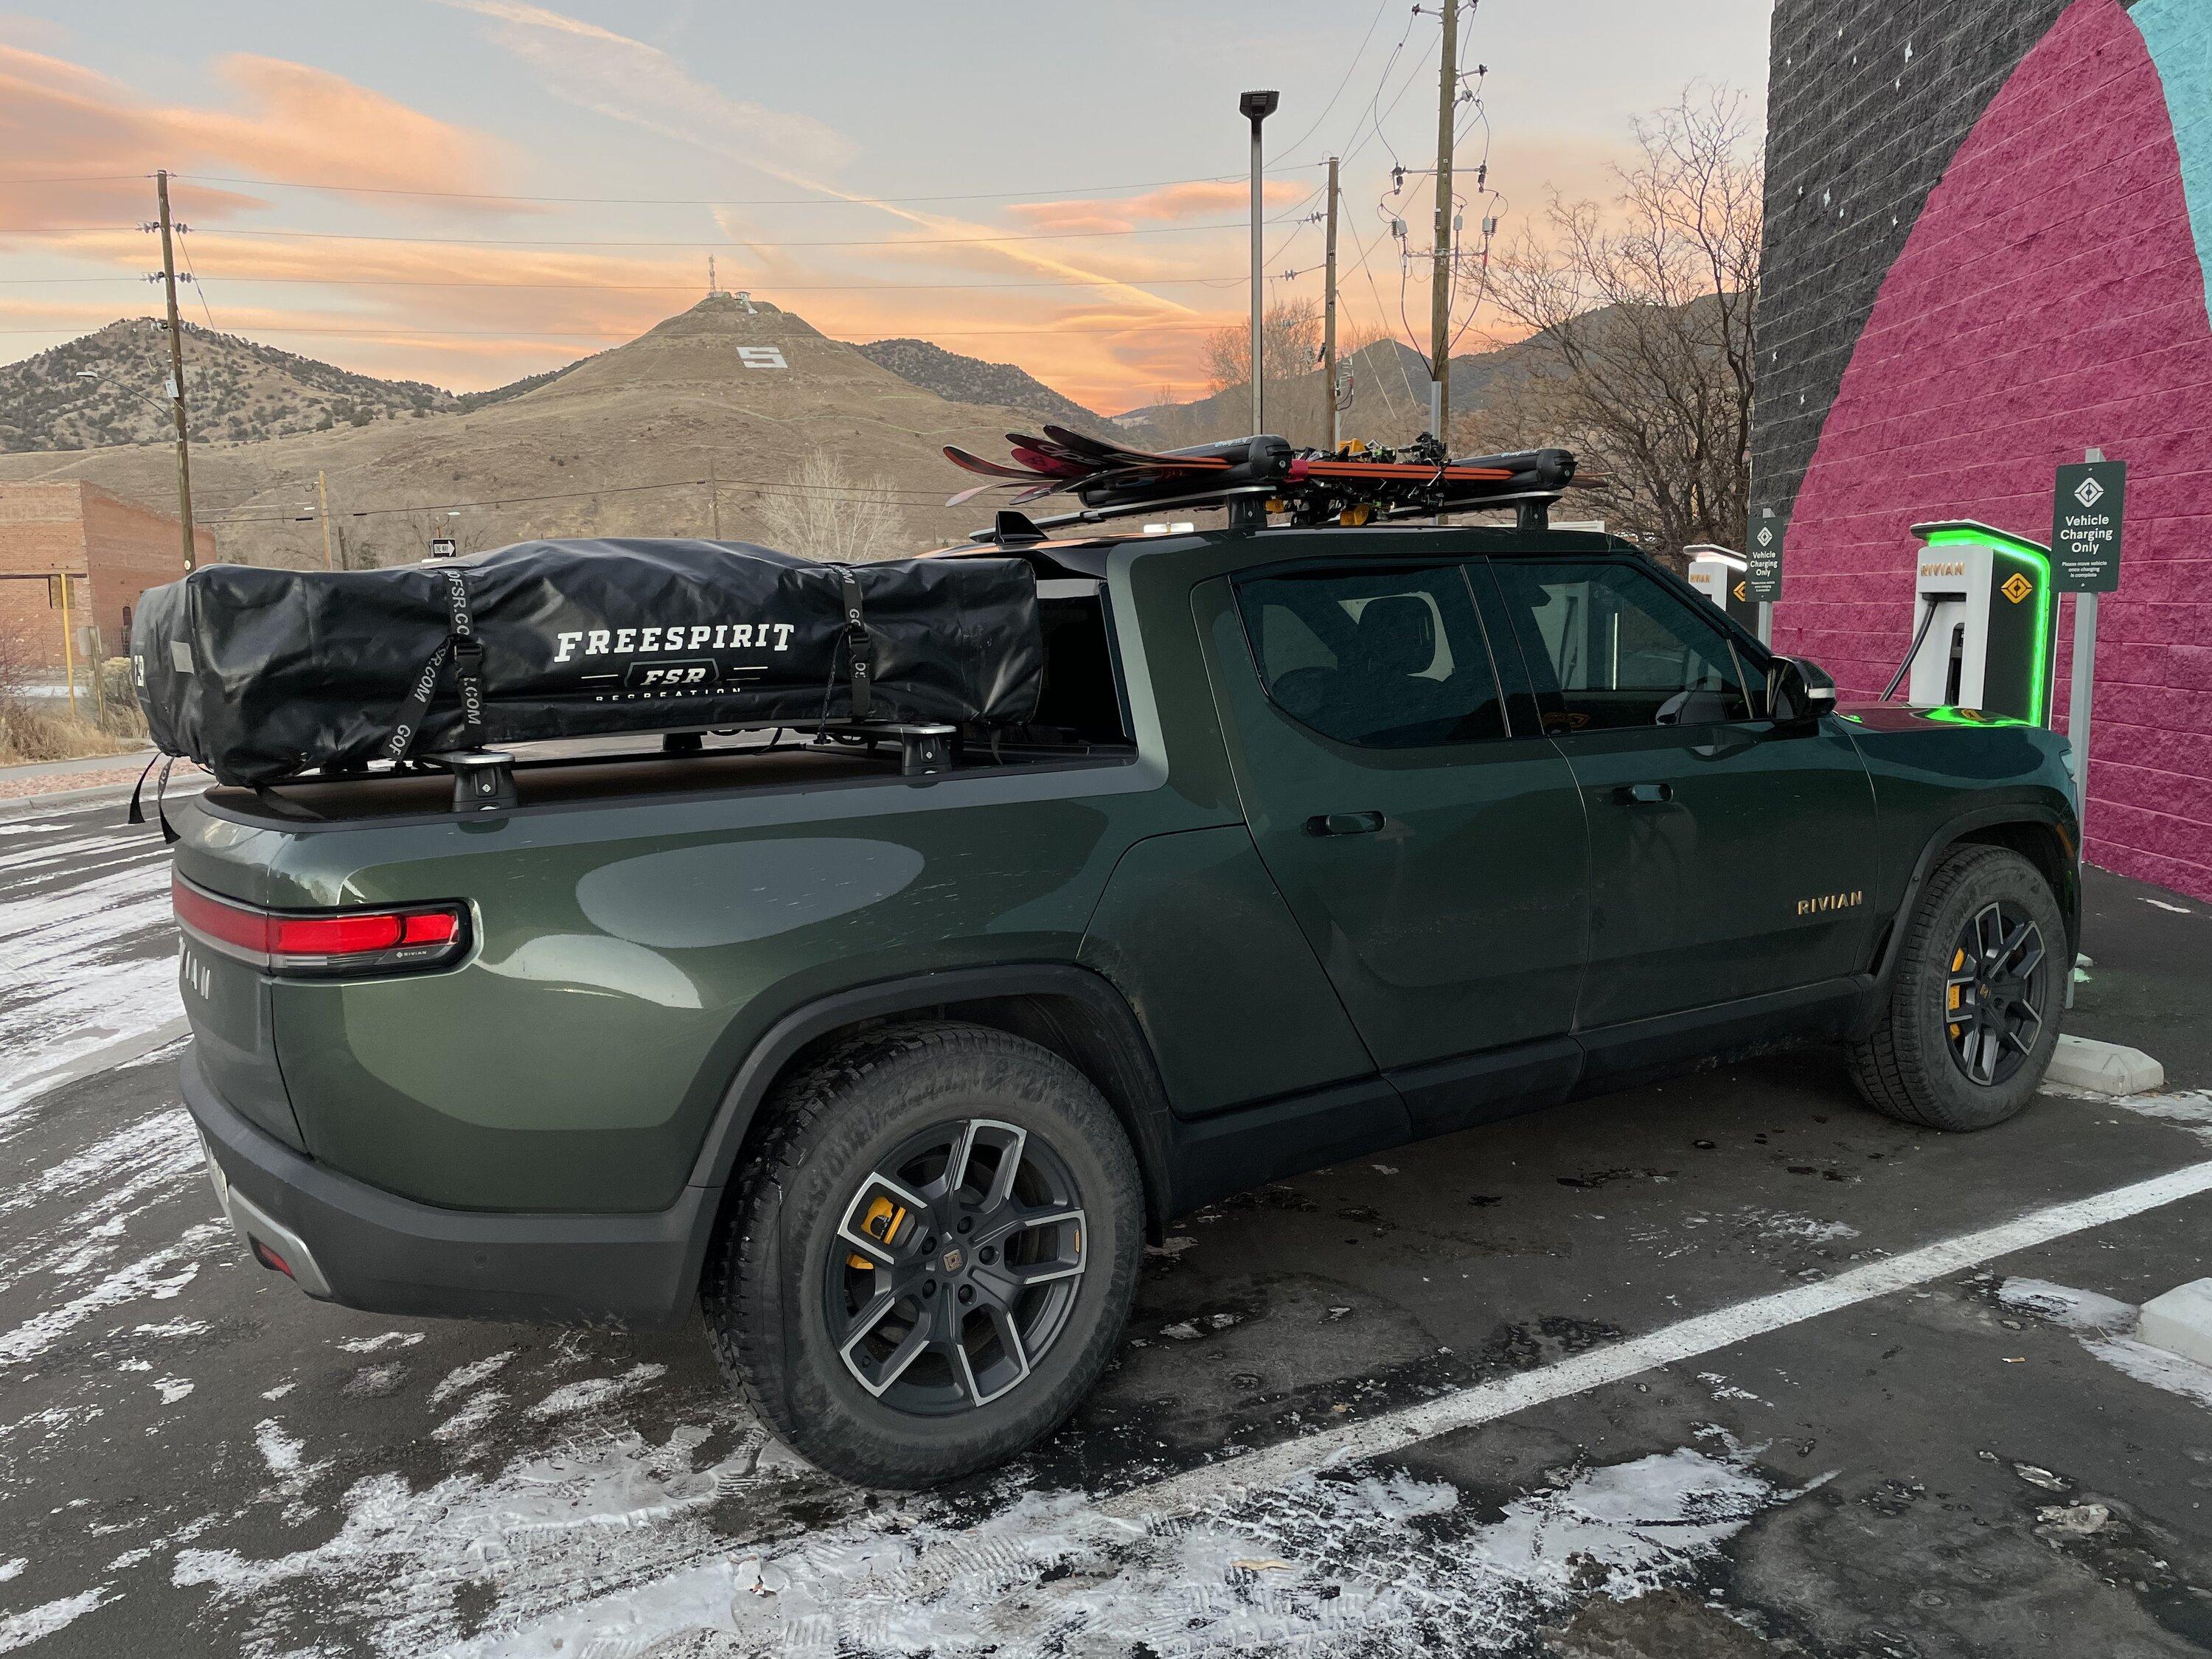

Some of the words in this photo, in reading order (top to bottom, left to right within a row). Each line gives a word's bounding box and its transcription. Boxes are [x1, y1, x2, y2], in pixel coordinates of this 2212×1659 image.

[737, 347, 788, 368] S
[2066, 515, 2110, 526] Vehicle
[2060, 528, 2113, 541] Charging
[1752, 551, 1776, 559] Vehicle
[2071, 541, 2100, 555] Only
[1750, 560, 1778, 568] Charging
[1920, 560, 1965, 577] RIVIAN
[1756, 568, 1771, 577] Only
[554, 623, 795, 663] FREESPIRIT
[640, 667, 706, 686] FSR
[596, 686, 741, 701] RECREATION
[389, 724, 411, 755] GOF
[1798, 890, 1863, 915] RIVIAN
